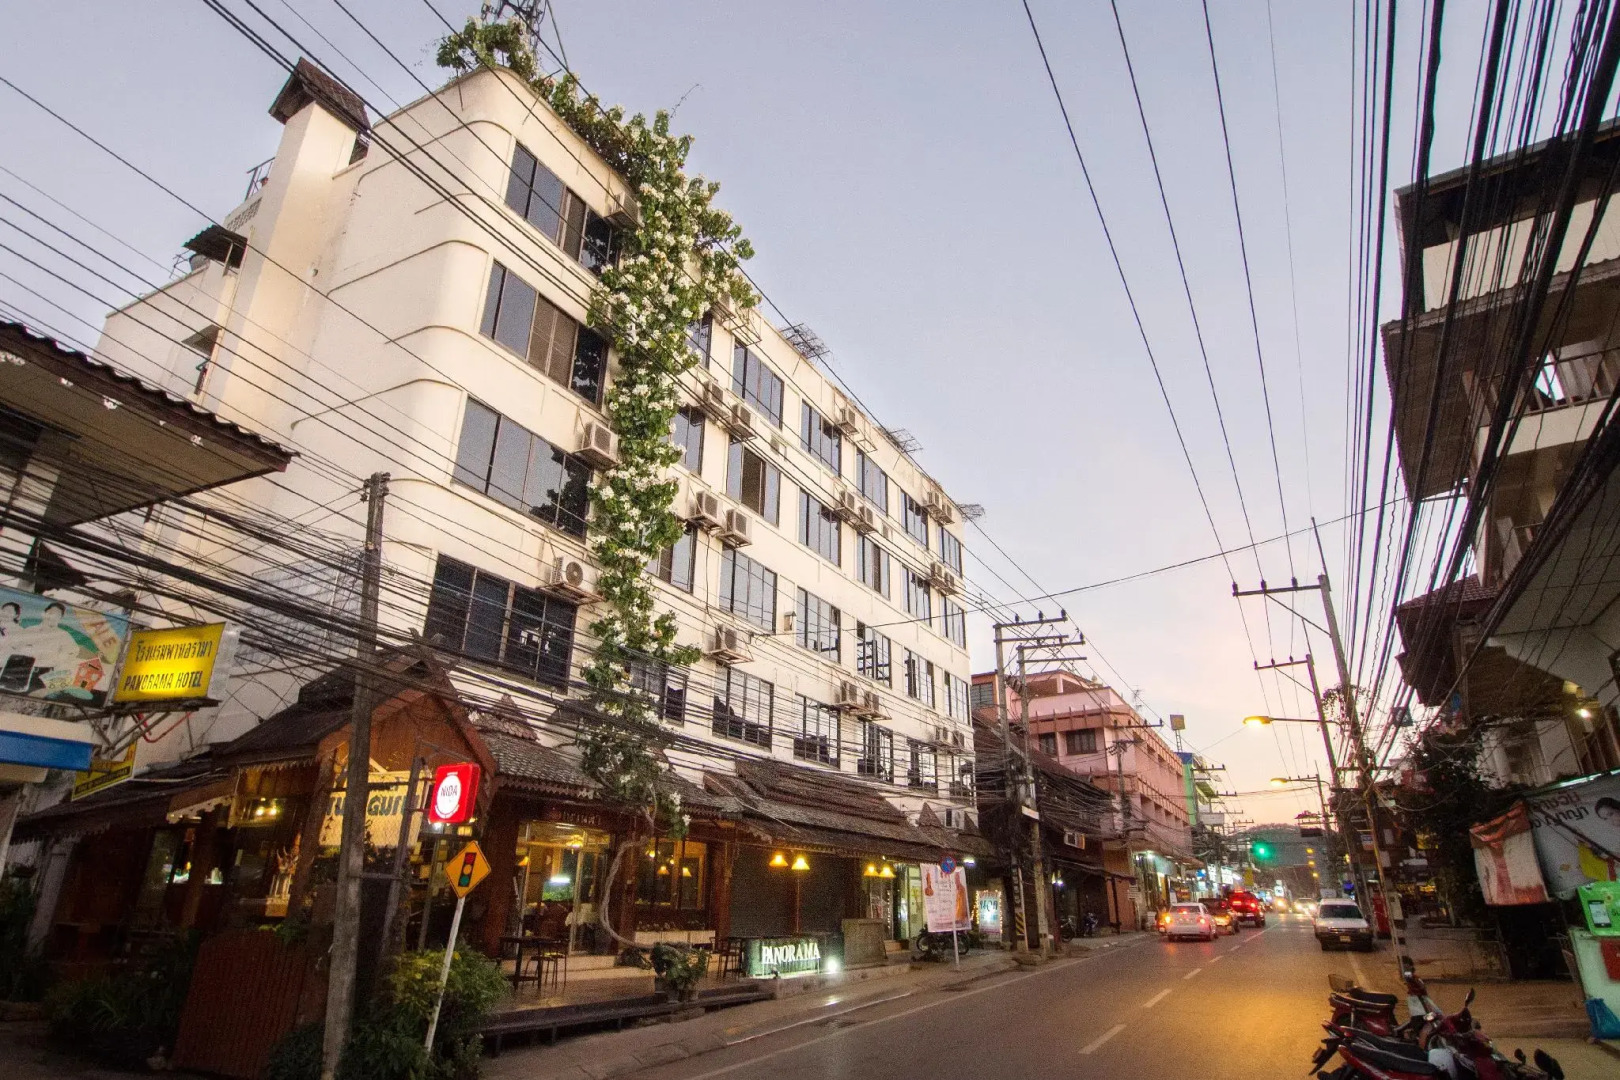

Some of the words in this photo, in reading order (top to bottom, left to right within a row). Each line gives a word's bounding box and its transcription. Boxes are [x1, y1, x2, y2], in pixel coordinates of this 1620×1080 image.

[123, 672, 174, 691] PANORAMA
[175, 670, 204, 689] HOTEL
[761, 942, 821, 965] PANORAMA
